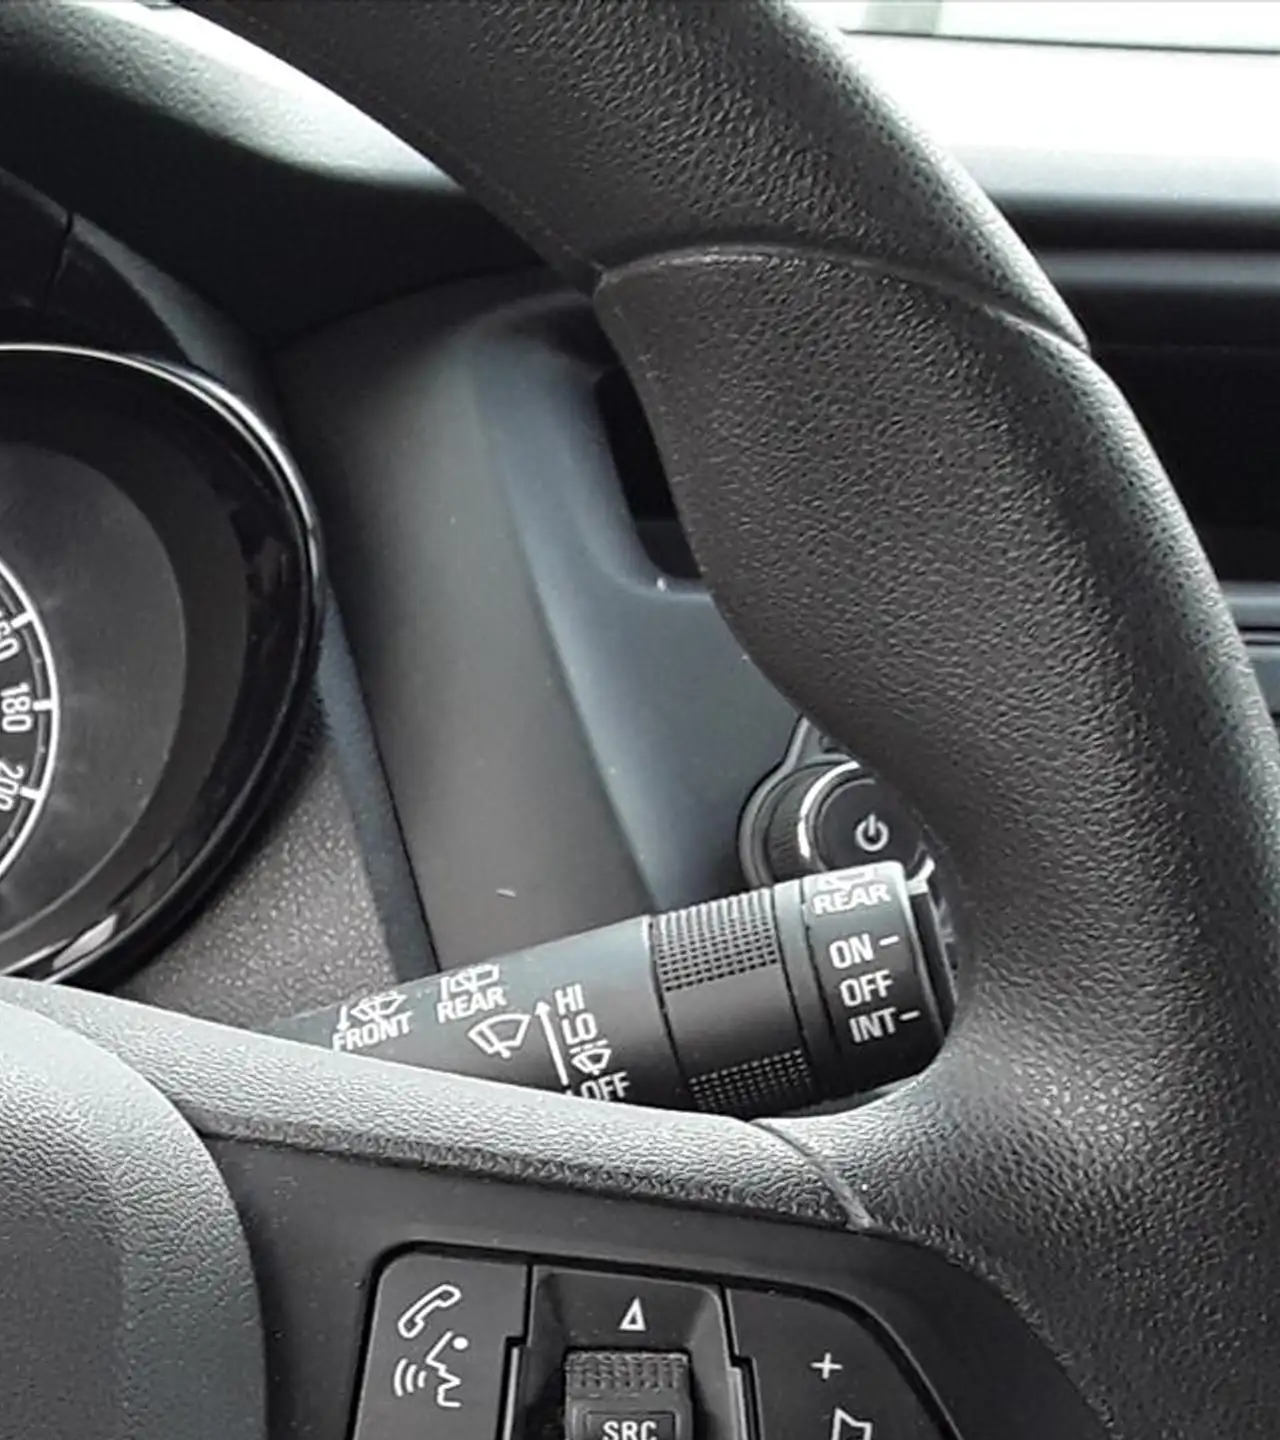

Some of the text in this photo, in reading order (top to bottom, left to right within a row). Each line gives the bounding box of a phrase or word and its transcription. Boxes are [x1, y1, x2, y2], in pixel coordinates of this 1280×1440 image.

[0, 682, 30, 733] 180
[812, 883, 892, 916] REAR
[828, 932, 874, 970] ON
[437, 986, 507, 1023] REAR
[554, 982, 585, 1016] HI
[839, 968, 894, 1008] OFF
[332, 1011, 413, 1052] FRONT
[561, 1012, 598, 1046] LO
[848, 1007, 897, 1044] INT
[580, 1070, 631, 1100] OFF
